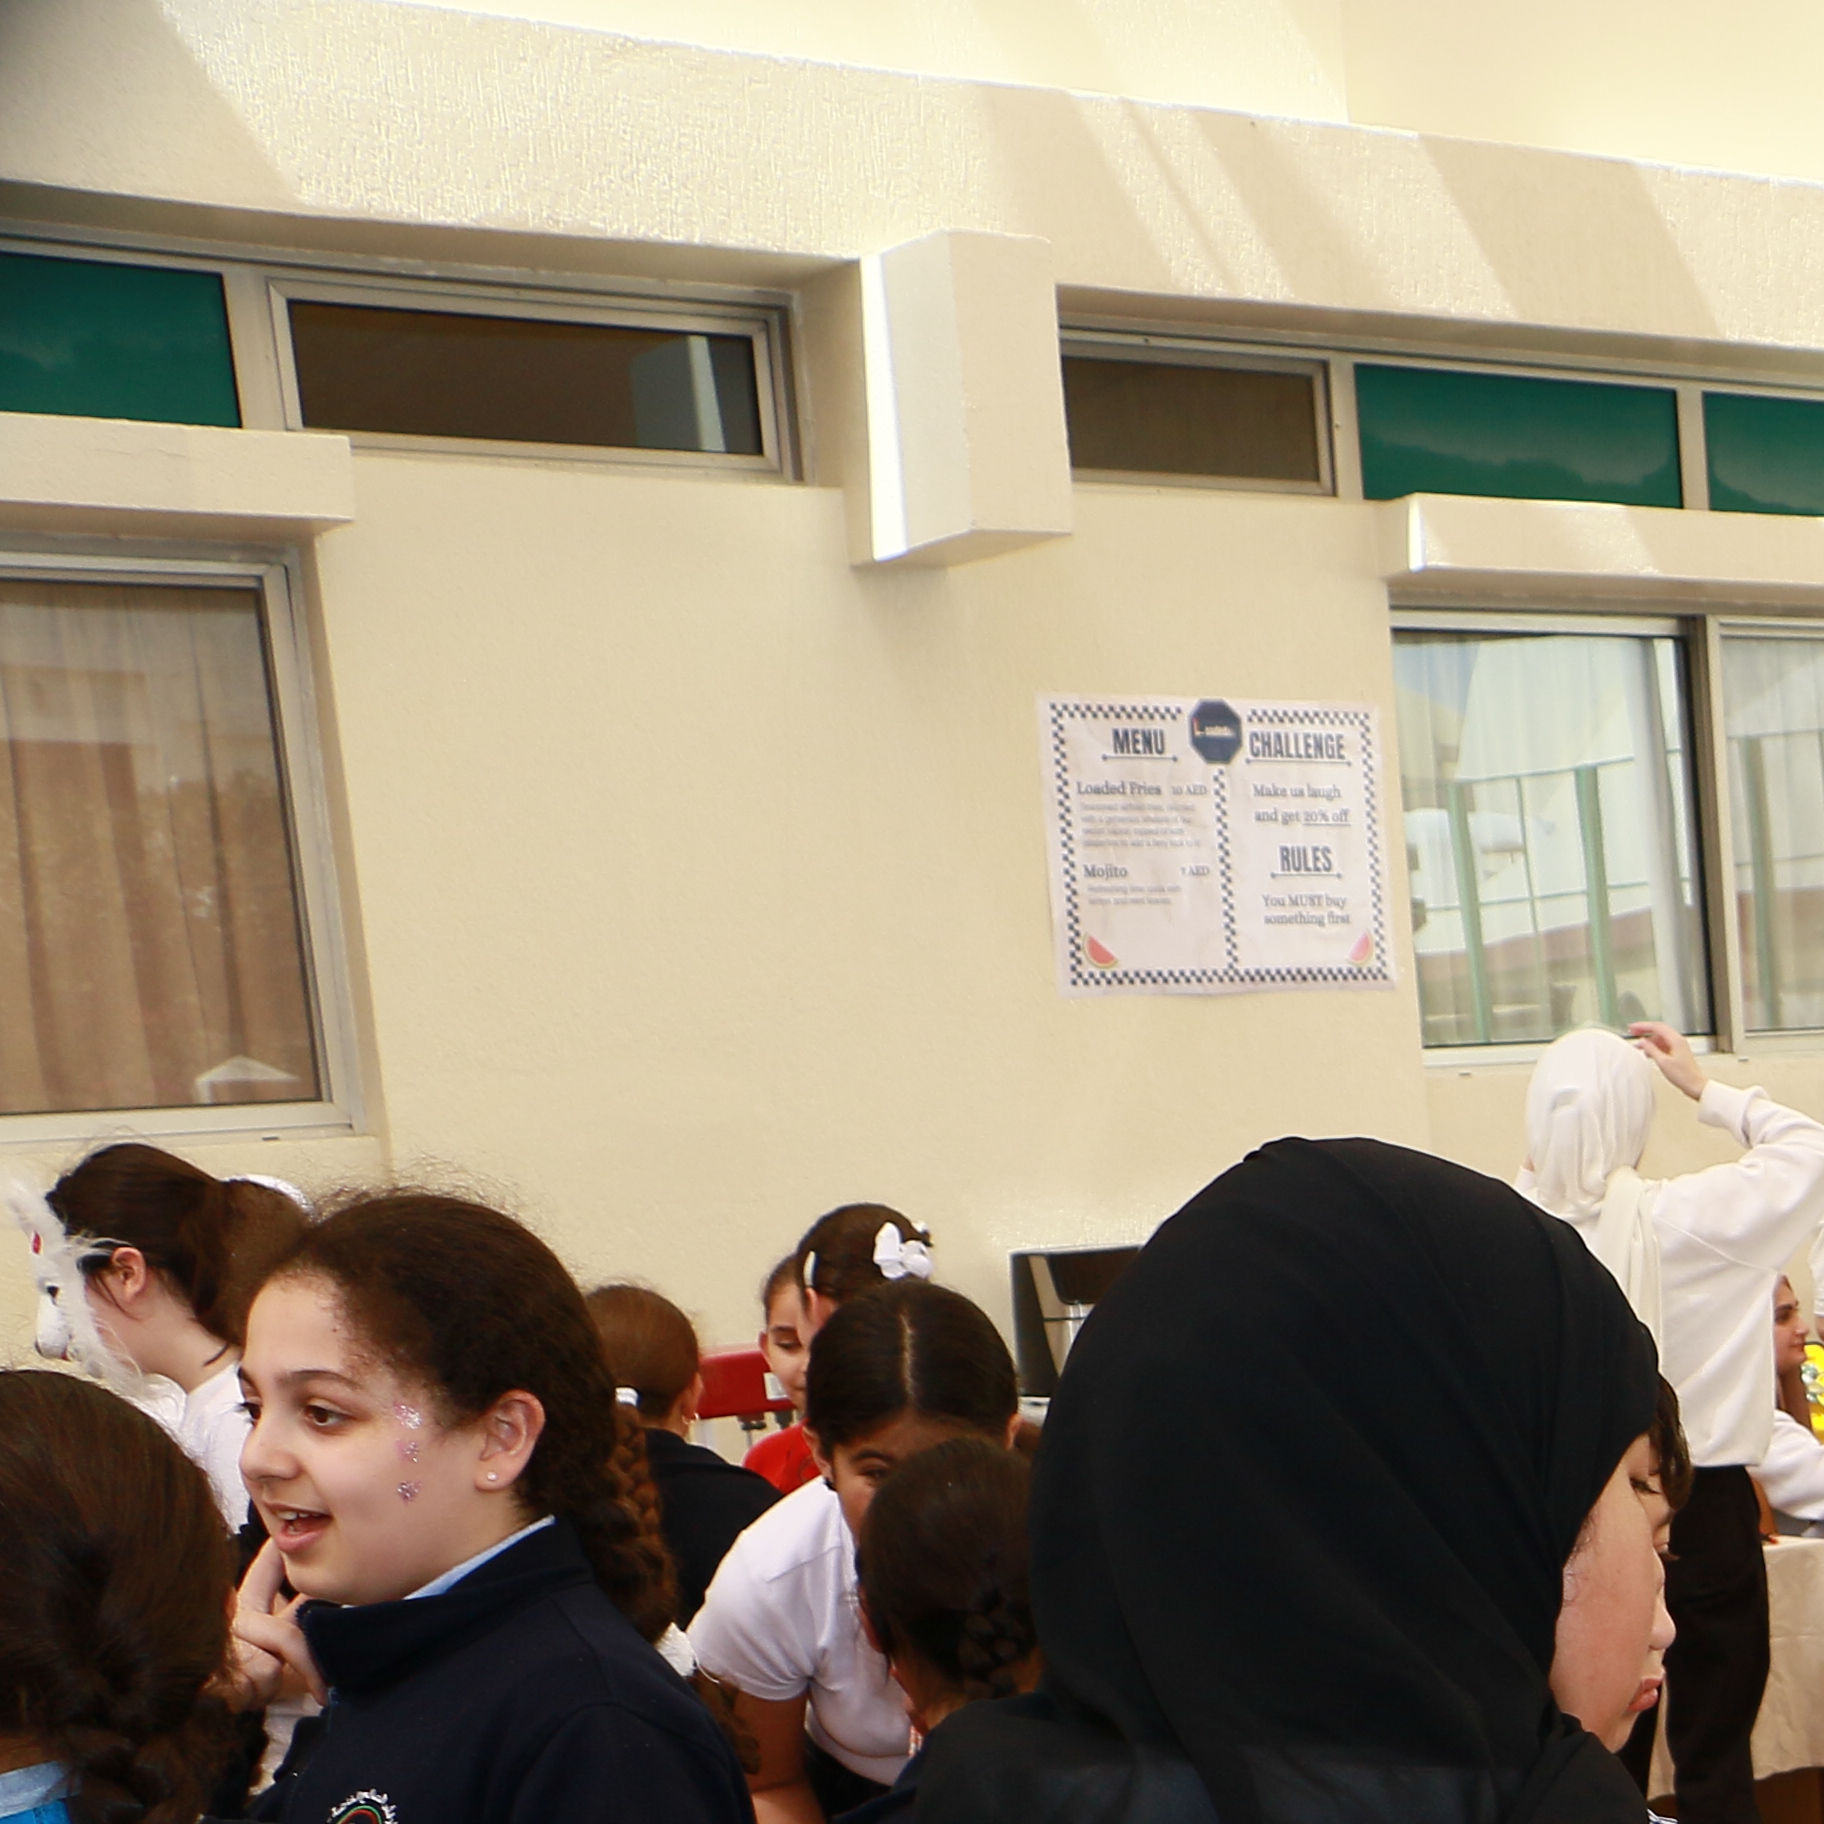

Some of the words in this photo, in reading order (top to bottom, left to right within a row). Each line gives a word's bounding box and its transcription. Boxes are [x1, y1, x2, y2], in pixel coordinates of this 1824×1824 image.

[1112, 728, 1165, 755] MENU
[1250, 730, 1346, 760] CHALLENGE
[1076, 781, 1125, 796] Loaded
[1128, 782, 1162, 796] Fries
[1185, 785, 1207, 796] AED
[1253, 784, 1286, 799] Make
[1288, 788, 1304, 798] us
[1307, 784, 1342, 801] laugh
[1254, 810, 1278, 823] and
[1281, 812, 1301, 826] get
[1304, 810, 1329, 823] 20%
[1332, 809, 1351, 823] off
[1279, 846, 1332, 872] RULES
[1083, 864, 1128, 880] Mojito
[1189, 865, 1210, 876] AED
[1263, 894, 1286, 907] You
[1289, 895, 1323, 907] MUST
[1326, 894, 1347, 910] buy
[1264, 912, 1324, 926] something
[1327, 912, 1351, 924] first
